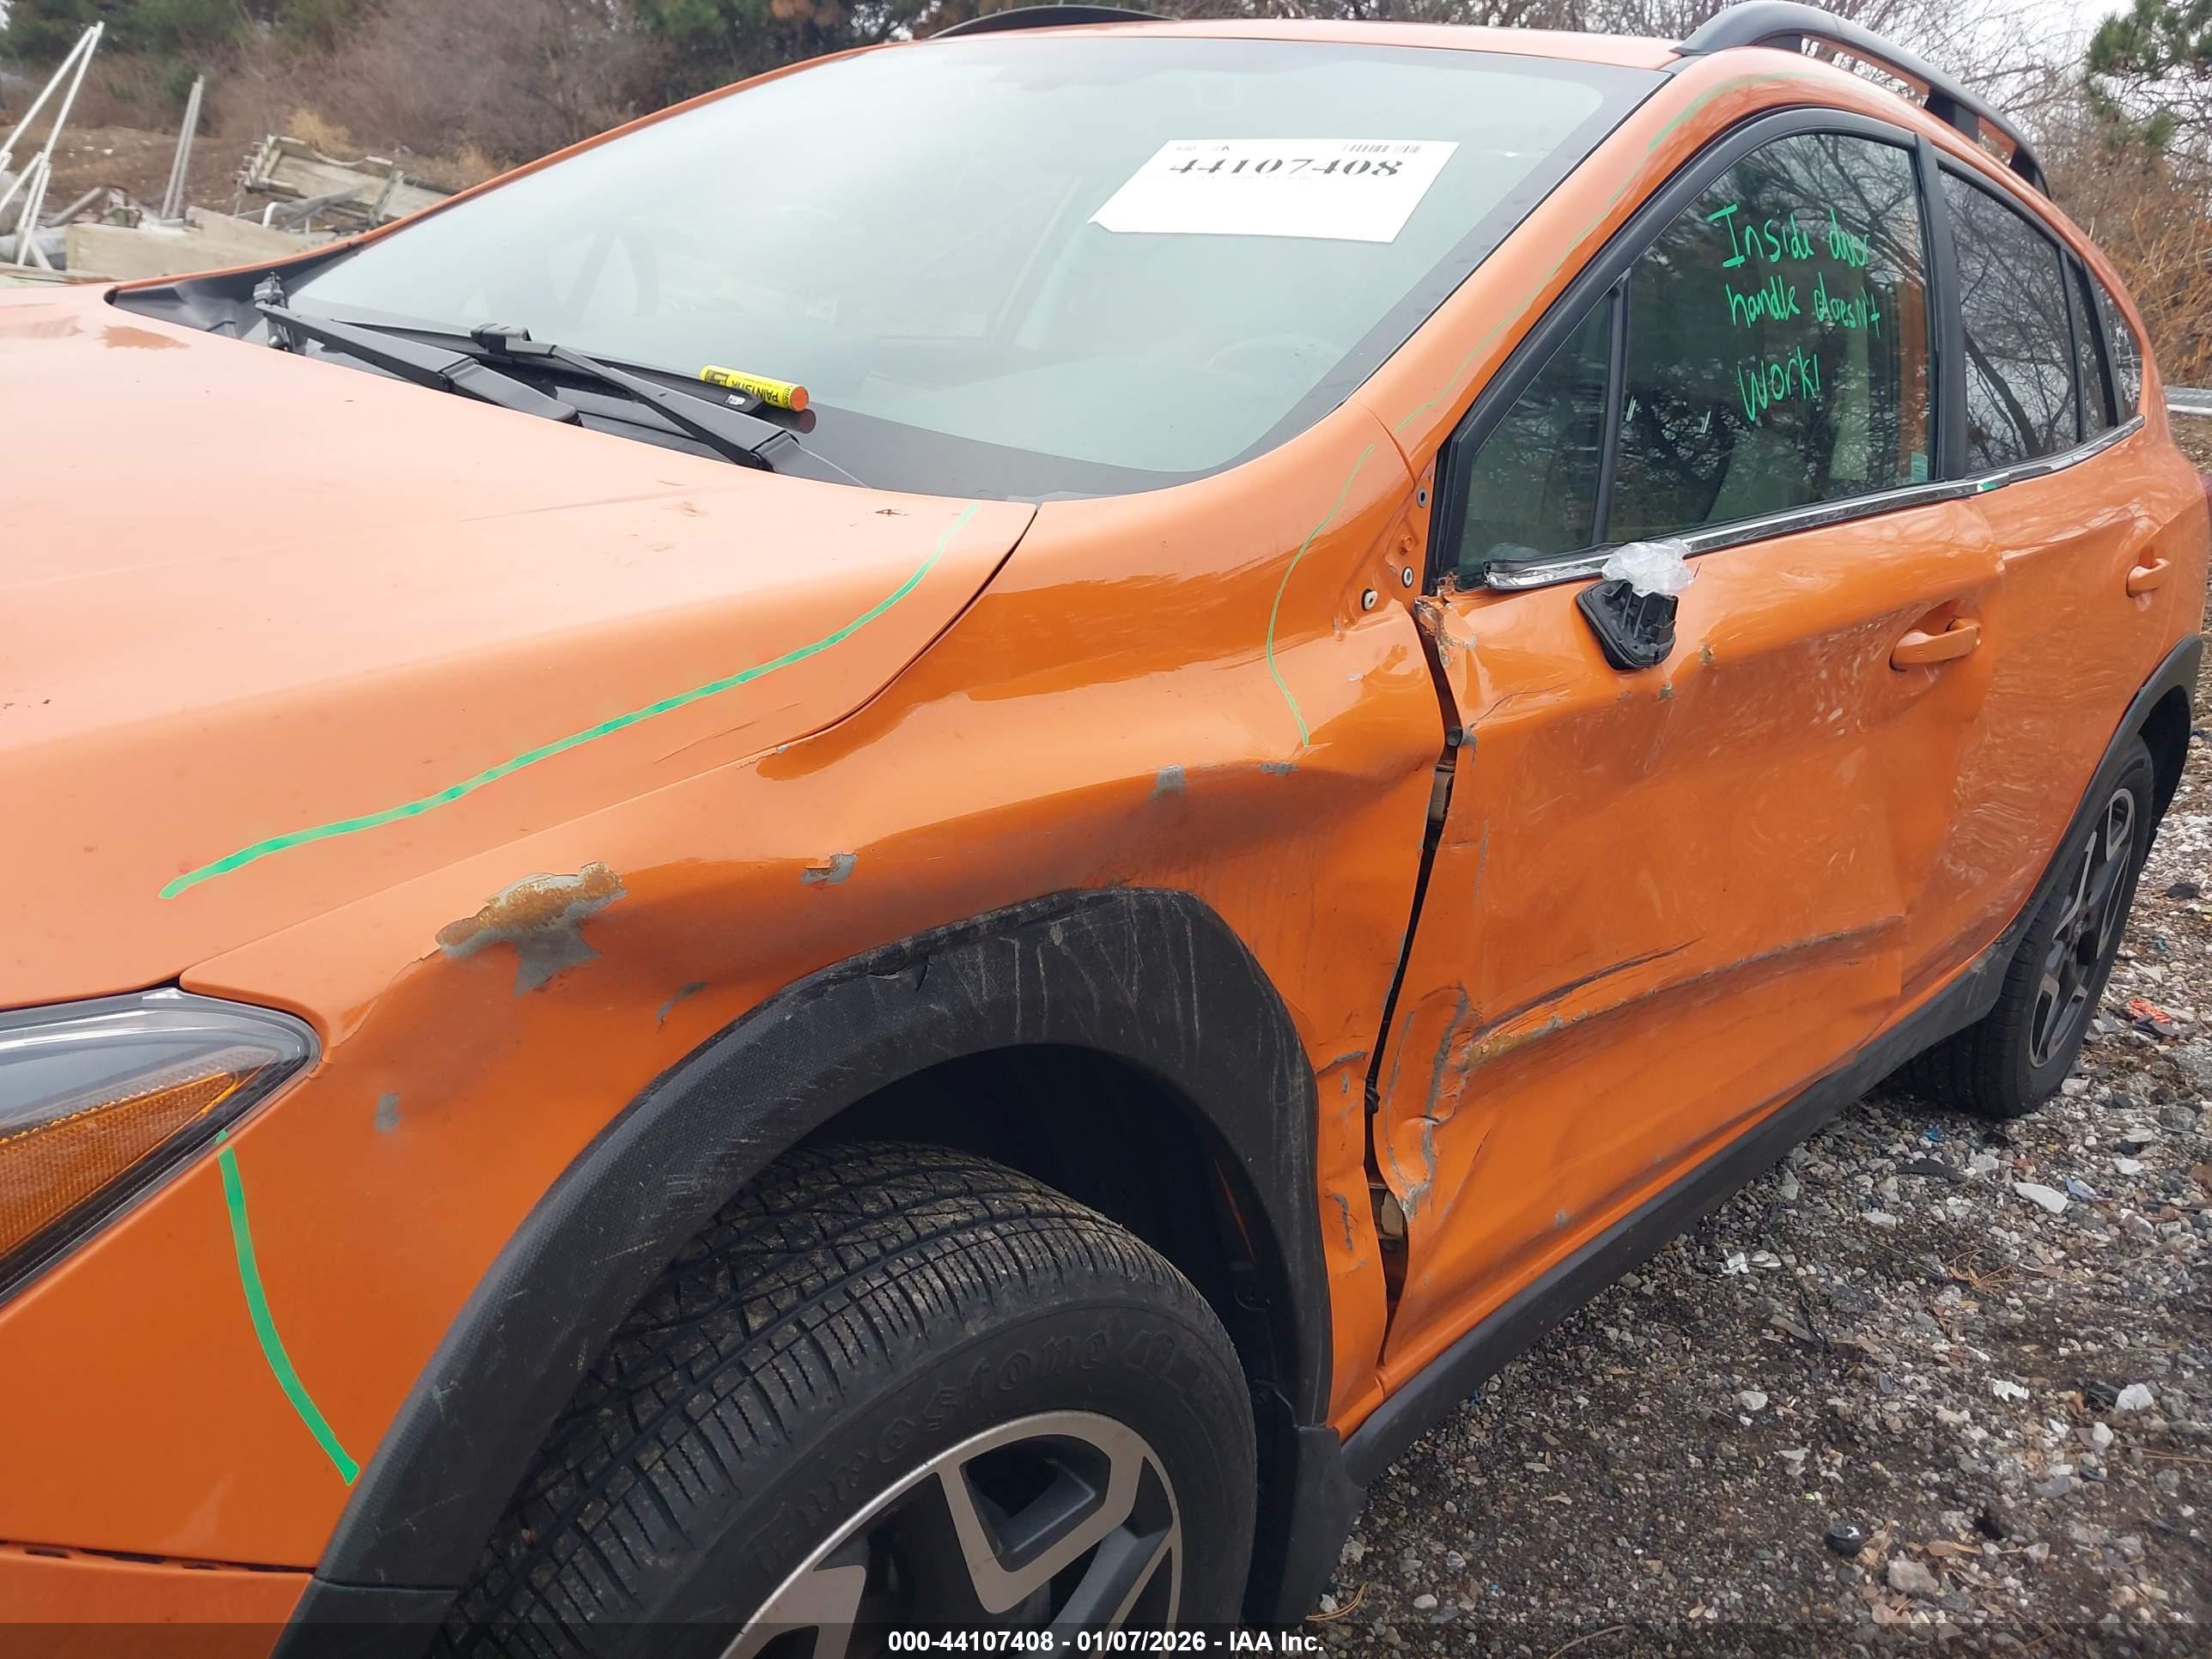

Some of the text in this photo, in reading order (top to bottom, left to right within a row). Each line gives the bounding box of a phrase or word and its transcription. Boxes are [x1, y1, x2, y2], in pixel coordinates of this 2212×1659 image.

[1169, 158, 1405, 177] 44107408
[1707, 204, 1870, 268] Inside door
[1725, 271, 1881, 338] handle doesn't
